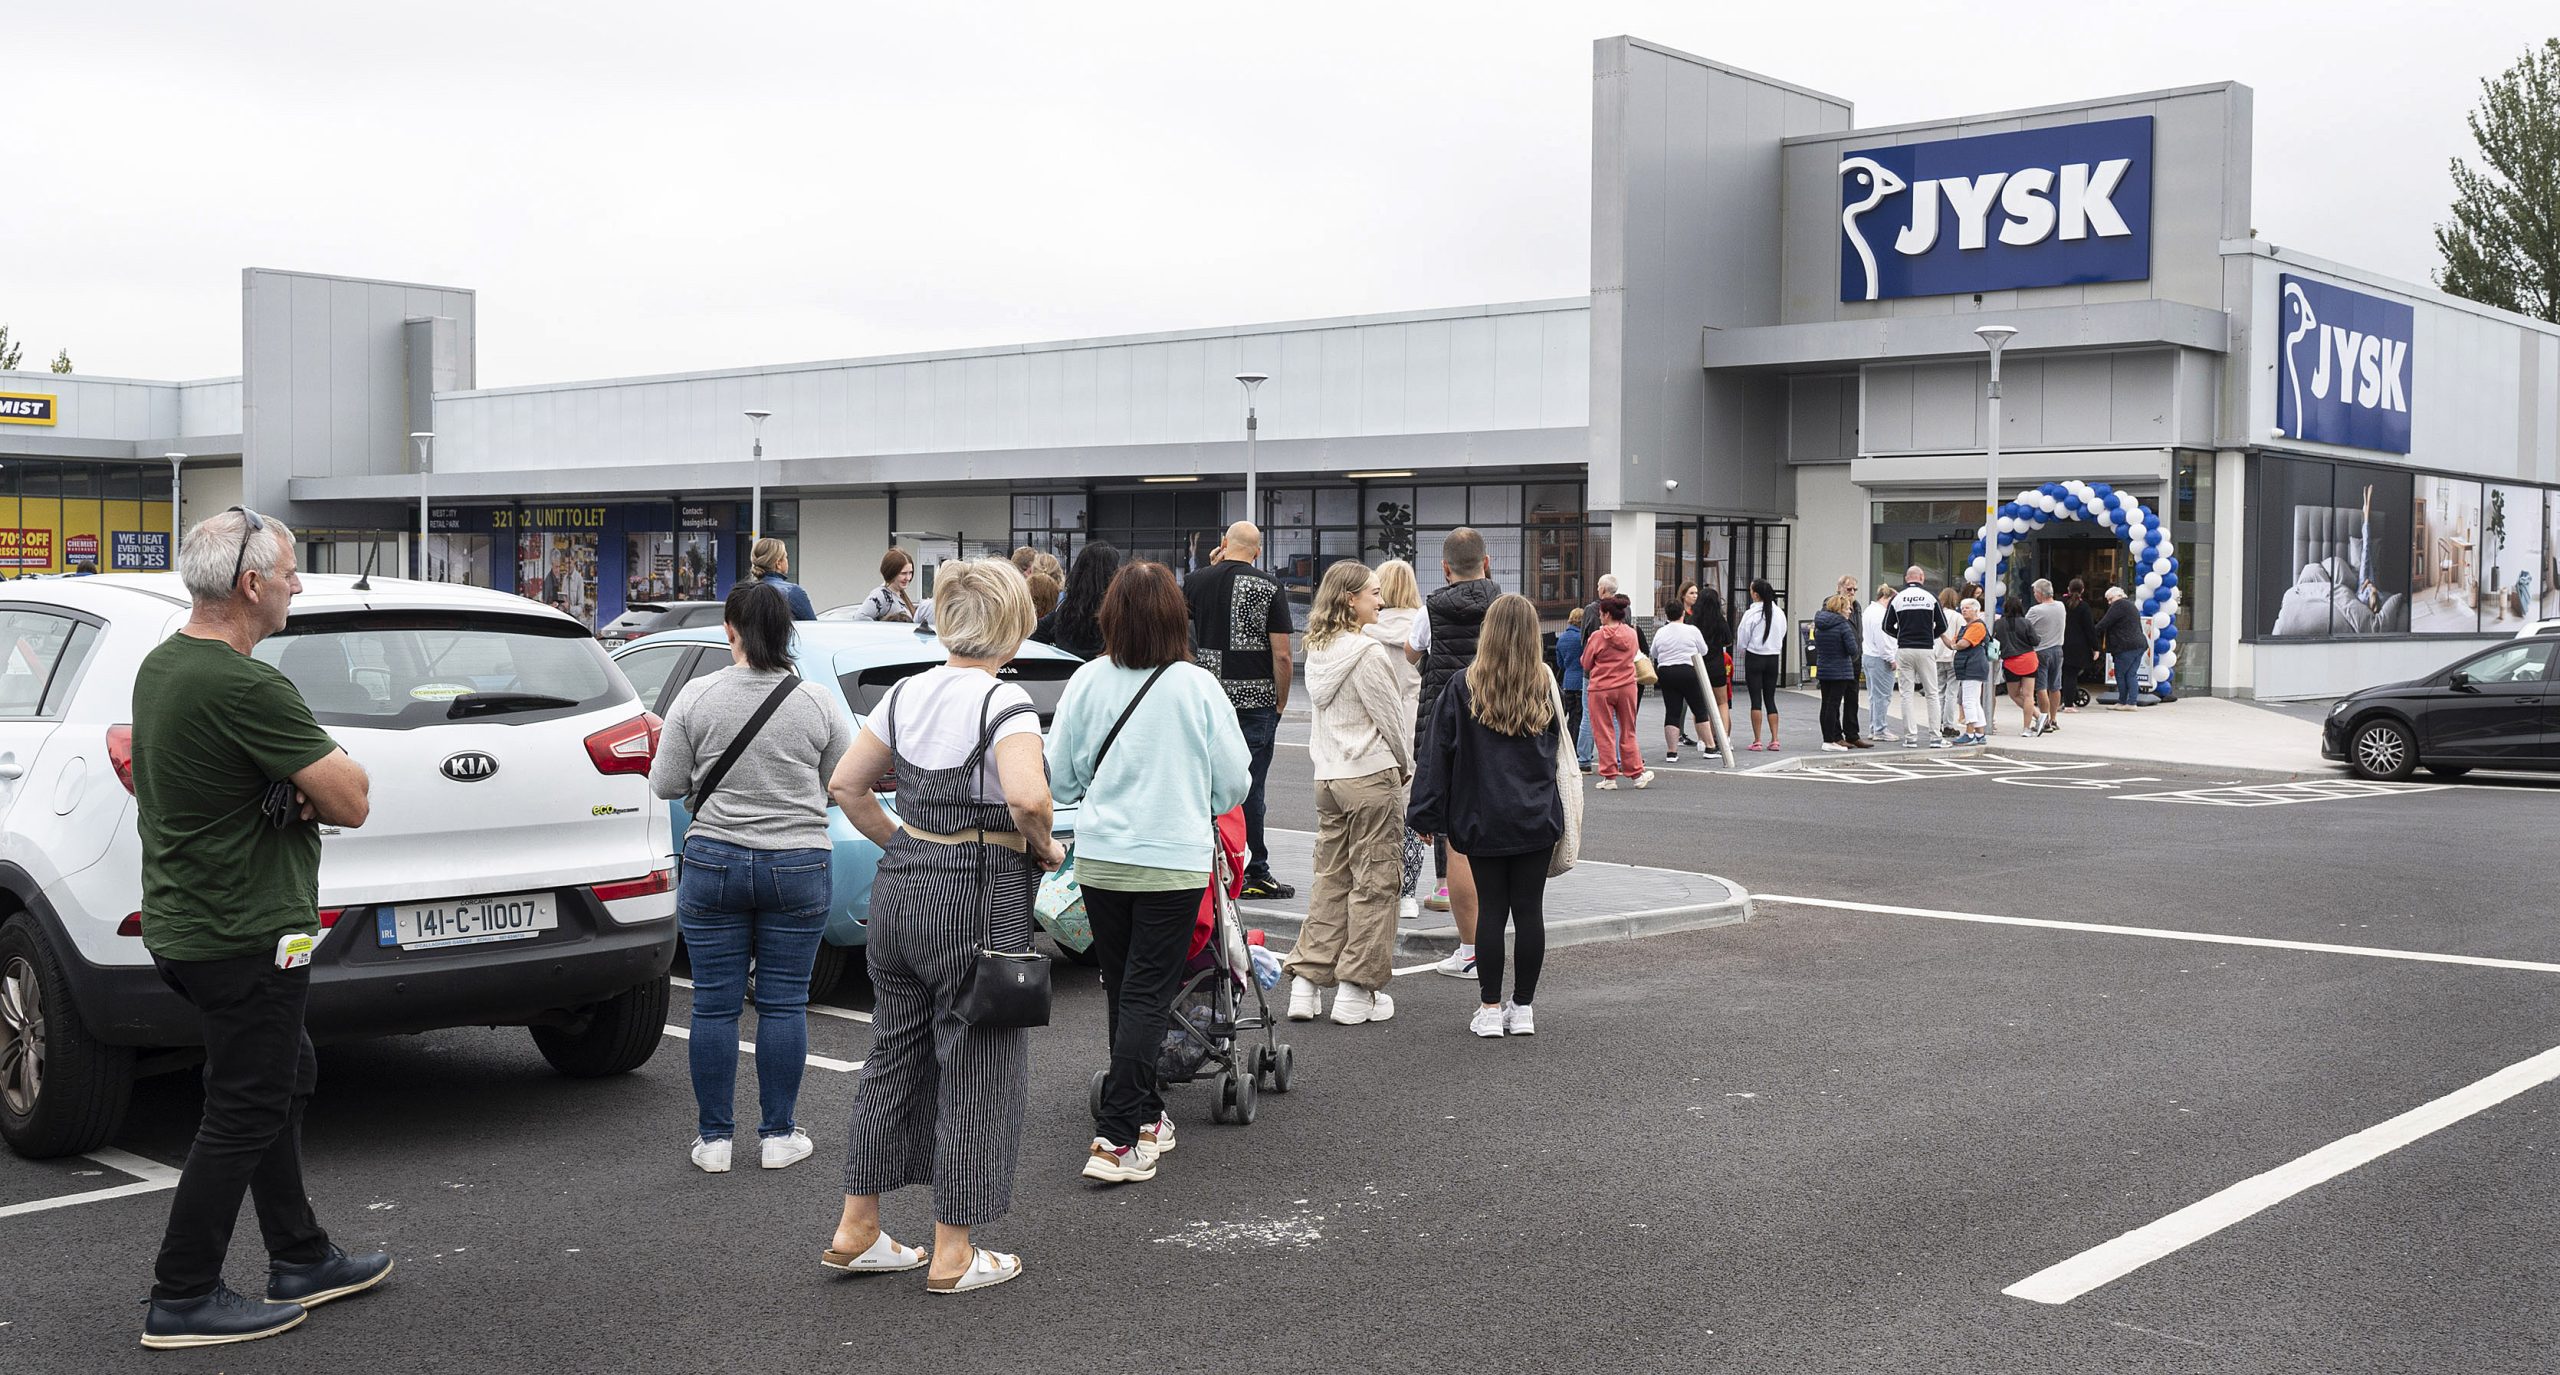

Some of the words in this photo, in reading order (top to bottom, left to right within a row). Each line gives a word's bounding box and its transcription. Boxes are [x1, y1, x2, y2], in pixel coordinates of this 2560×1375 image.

[1893, 157, 2132, 256] JYSK
[2311, 323, 2408, 413] JYSK
[0, 400, 44, 416] MIST
[492, 510, 512, 528] 321
[536, 508, 565, 527] UNIT
[565, 508, 583, 527] TO
[584, 508, 606, 527] LET
[0, 532, 26, 546] 70%
[26, 532, 49, 546] OFF
[118, 533, 136, 544] WE
[137, 534, 164, 545] BEAT
[0, 547, 49, 557] ESCRPTIONS
[117, 544, 165, 553] EVERYONE'S
[117, 553, 165, 567] PRICES
[451, 756, 491, 776] KIA
[460, 898, 493, 906] CORCAIGH
[415, 900, 536, 938] 141-C-11007
[381, 929, 396, 939] IRL
